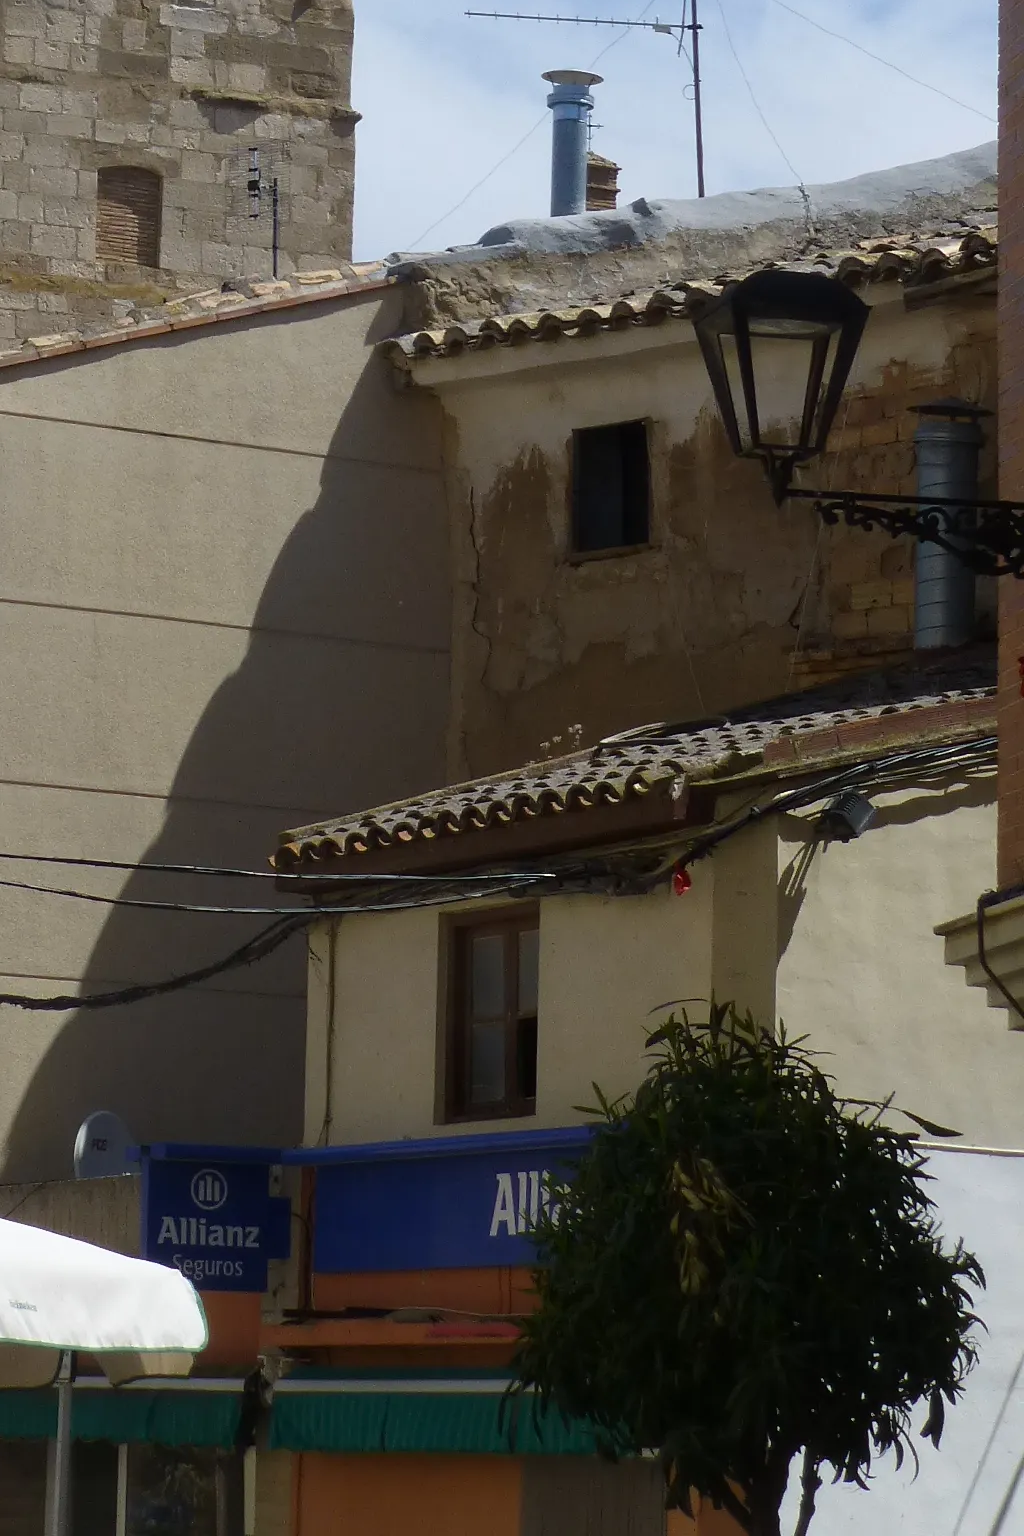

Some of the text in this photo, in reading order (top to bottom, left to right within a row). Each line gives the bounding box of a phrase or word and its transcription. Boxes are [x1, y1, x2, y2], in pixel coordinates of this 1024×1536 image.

[489, 1169, 584, 1236] Alli
[157, 1216, 260, 1248] Allianz
[172, 1254, 243, 1281] Seguros
